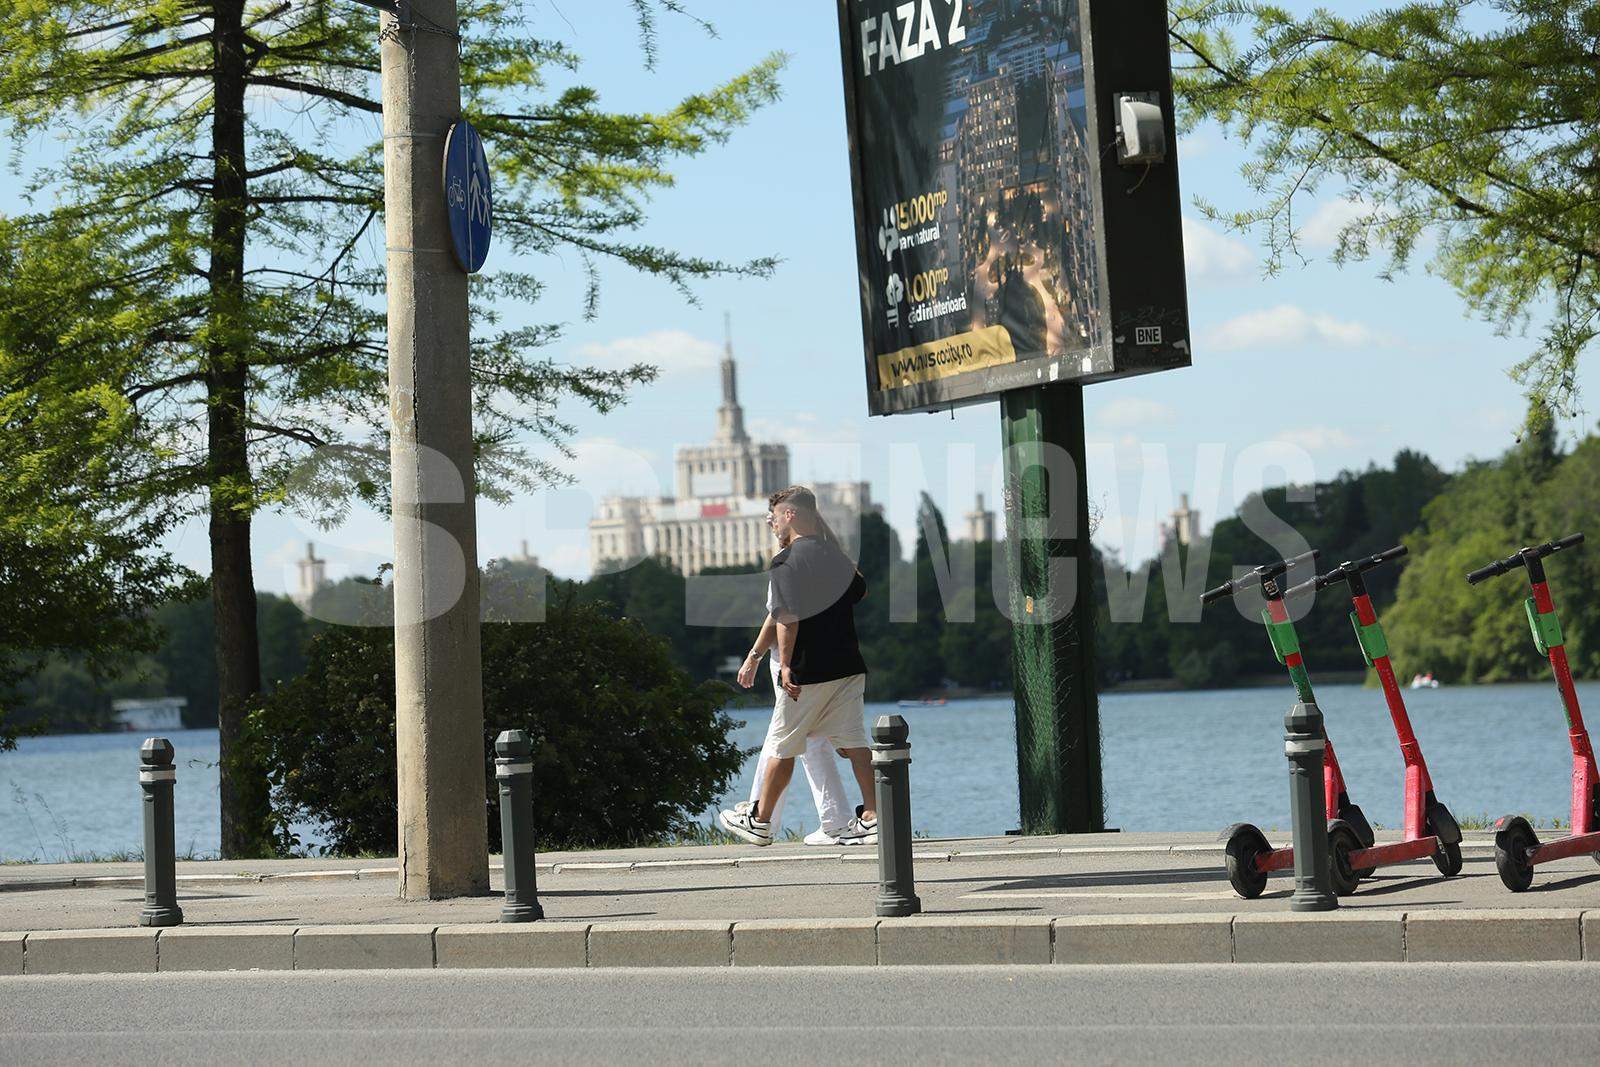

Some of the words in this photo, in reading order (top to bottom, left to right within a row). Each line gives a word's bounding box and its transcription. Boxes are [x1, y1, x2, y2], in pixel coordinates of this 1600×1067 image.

[861, 0, 941, 76] FAZA
[945, 0, 966, 45] 2
[1137, 328, 1160, 342] BNE
